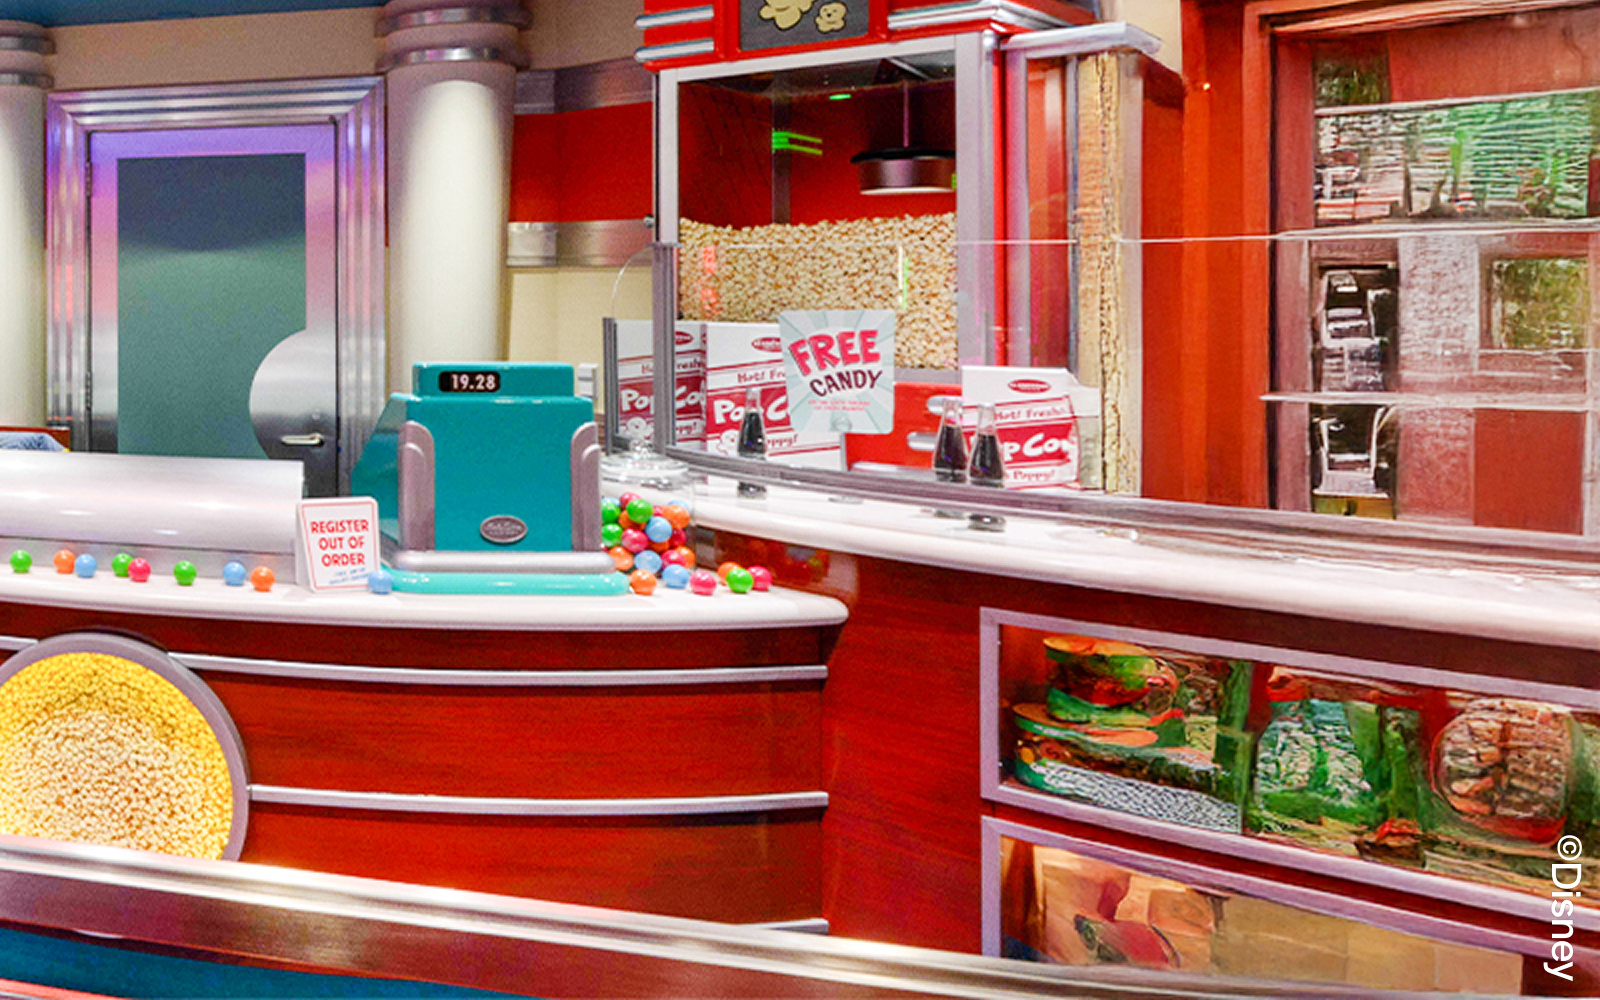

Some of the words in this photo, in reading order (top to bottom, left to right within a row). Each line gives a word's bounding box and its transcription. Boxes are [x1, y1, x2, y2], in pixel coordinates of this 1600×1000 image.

[788, 329, 882, 378] FREE
[452, 373, 496, 391] 19.28
[809, 369, 883, 398] CANDY
[310, 518, 369, 534] REGISTER
[318, 536, 344, 551] OUT
[347, 535, 365, 550] OF
[321, 552, 366, 567] ORDER
